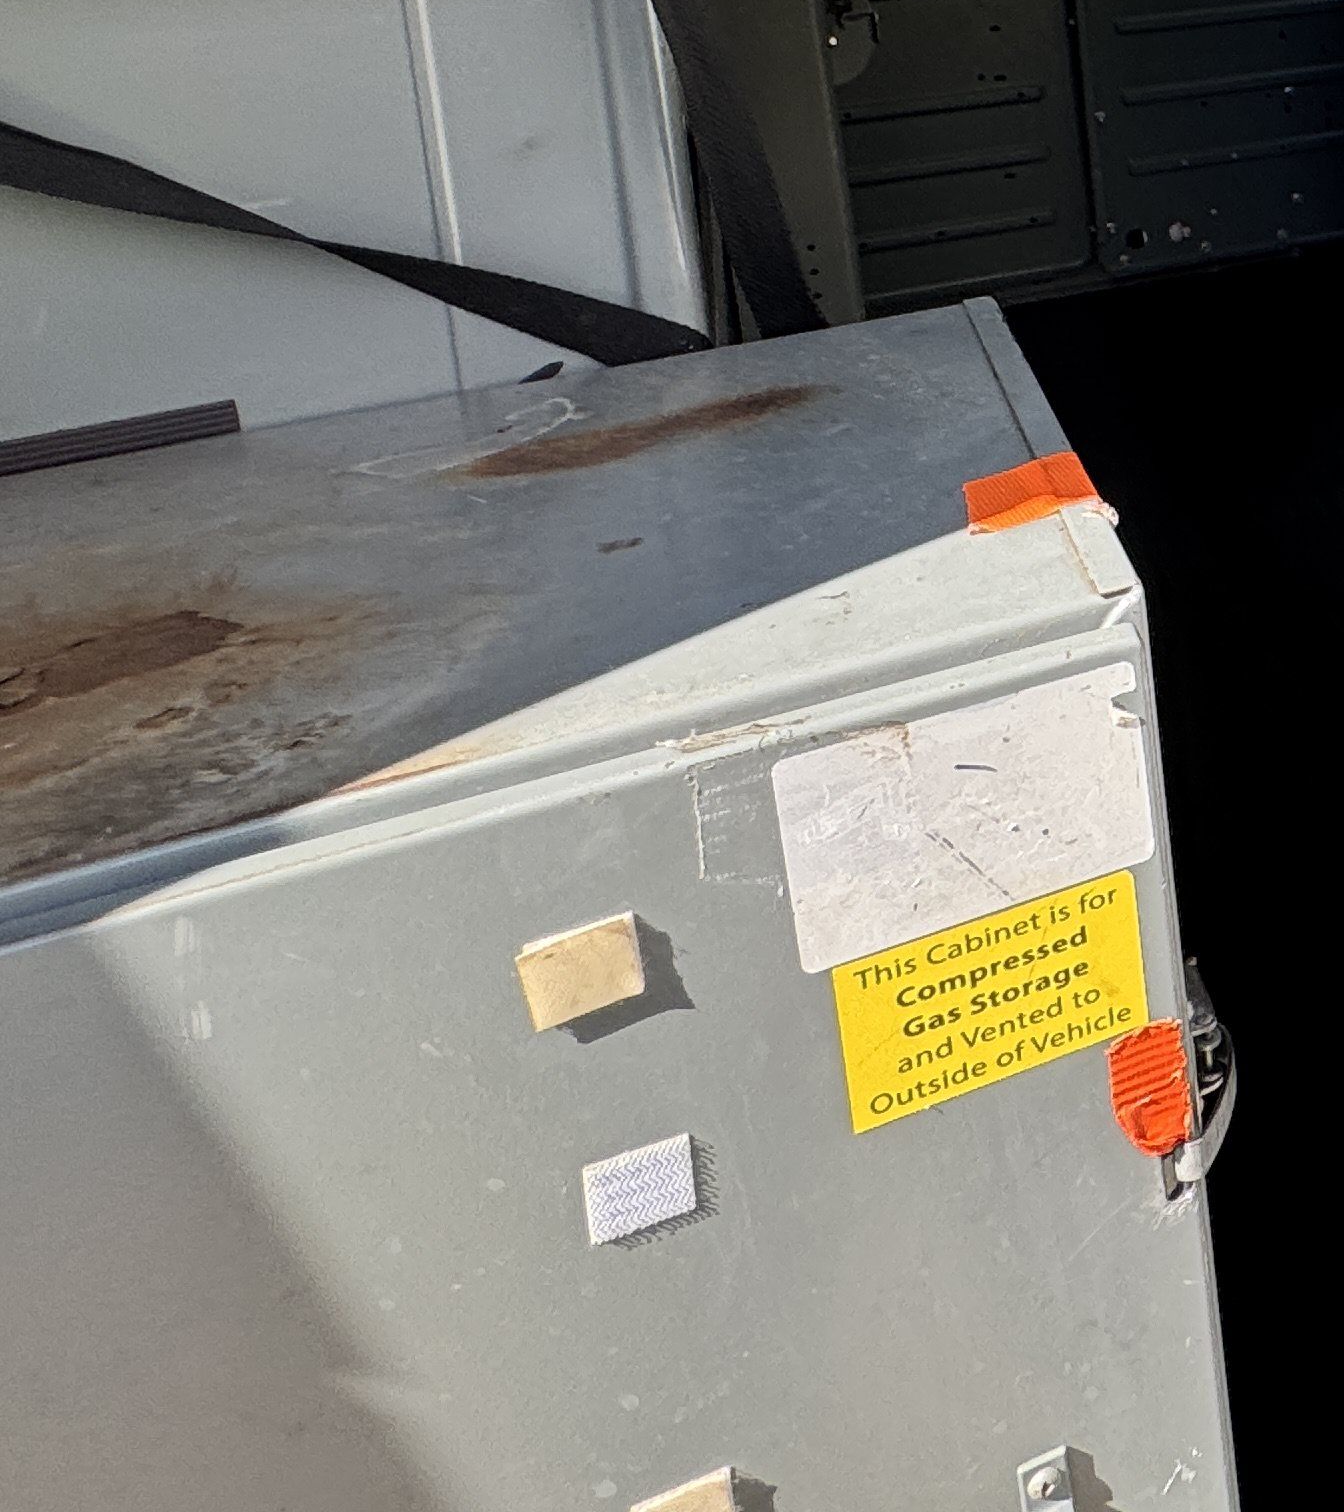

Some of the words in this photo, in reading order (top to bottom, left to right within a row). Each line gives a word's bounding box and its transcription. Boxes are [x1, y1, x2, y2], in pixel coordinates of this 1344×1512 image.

[853, 957, 917, 990] This
[927, 913, 1041, 966] Cabinet
[1050, 901, 1071, 924] is
[1078, 888, 1117, 914] for
[896, 926, 1088, 1007] Compressed
[897, 1036, 953, 1074] and
[960, 1001, 1063, 1048] Vented
[1072, 987, 1100, 1007] to
[903, 1006, 962, 1037] Gas
[970, 960, 1089, 1014] Storage
[870, 1059, 987, 1115] Outside
[997, 1040, 1024, 1068] of
[1031, 1005, 1132, 1054] Vehicle
